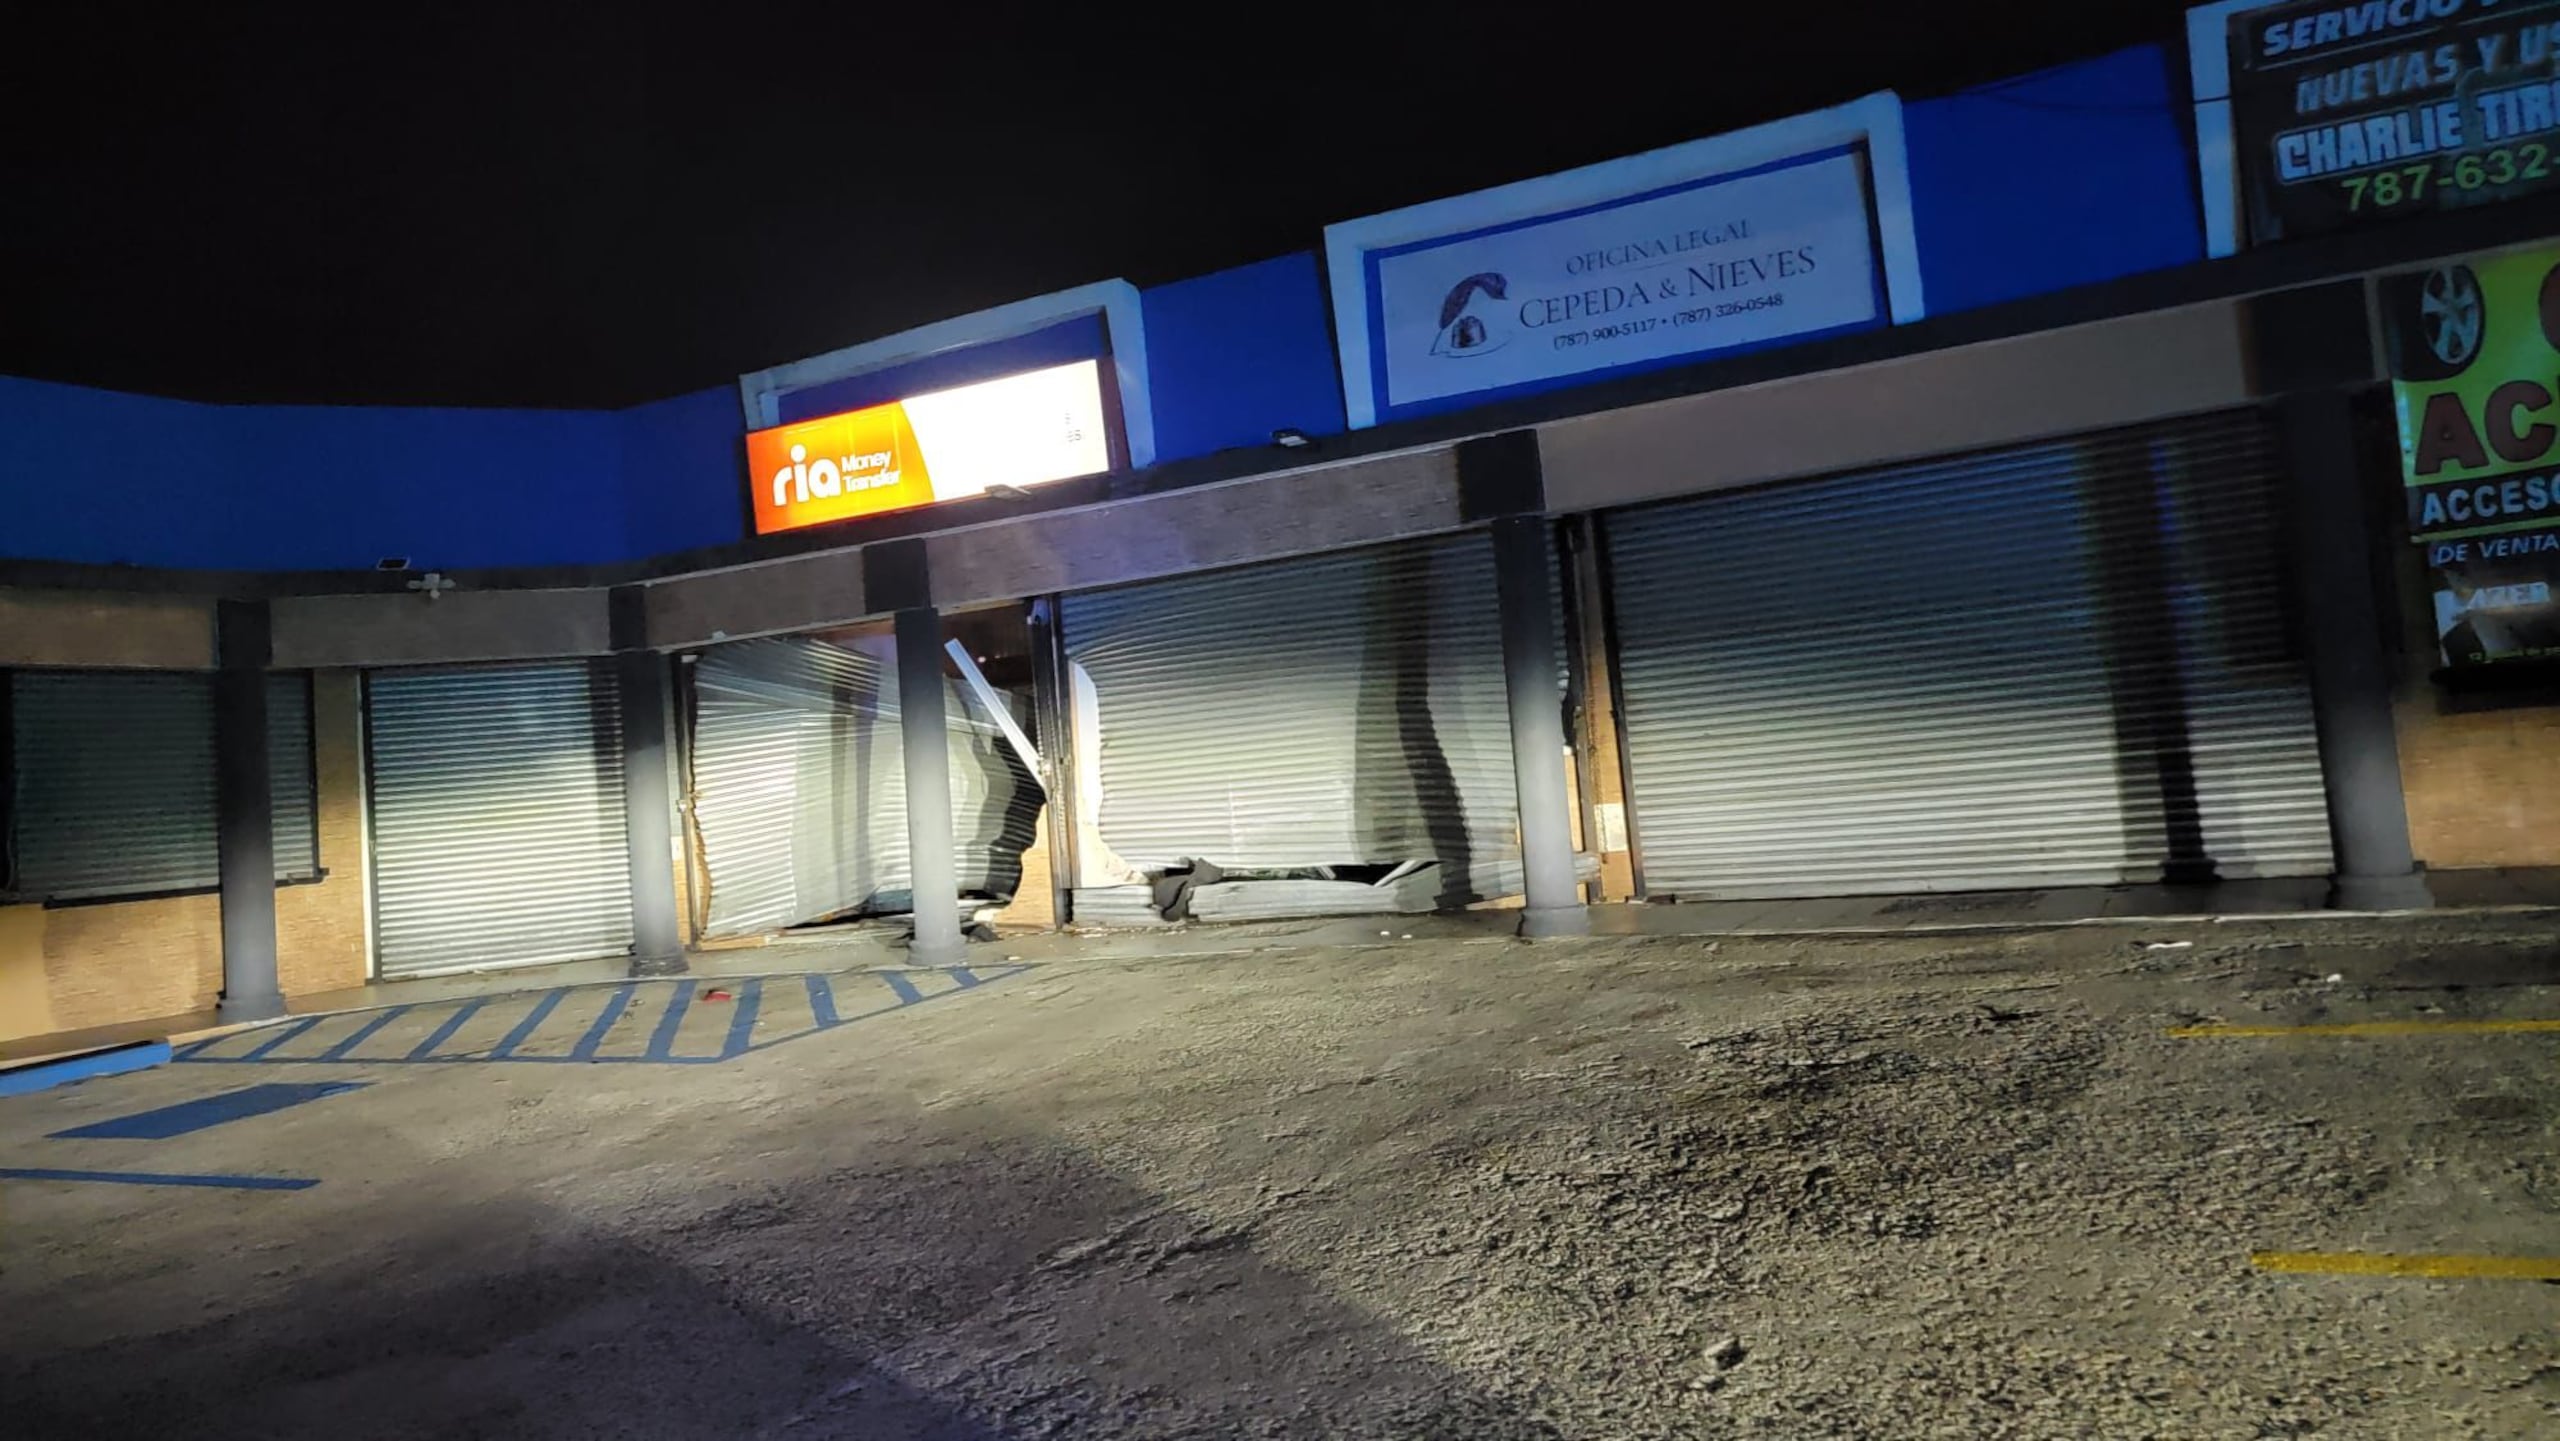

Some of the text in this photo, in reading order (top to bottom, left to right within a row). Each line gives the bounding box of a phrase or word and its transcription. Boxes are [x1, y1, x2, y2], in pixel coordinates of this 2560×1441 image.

[2263, 0, 2463, 56] SERVICIO
[2296, 44, 2459, 114] NUEVAS
[2477, 33, 2505, 74] Y
[2276, 101, 2464, 182] CHARLIE
[1566, 218, 1755, 276] OFICINA LEGAL
[1518, 246, 1817, 329] CEPEDA & NIEVES
[1553, 291, 1785, 349] (787) 900-5117 (787) 326-0548
[772, 443, 843, 507] ria
[840, 450, 893, 472] Money
[842, 468, 902, 493] Transfer
[2437, 533, 2560, 564] DE VENTA
